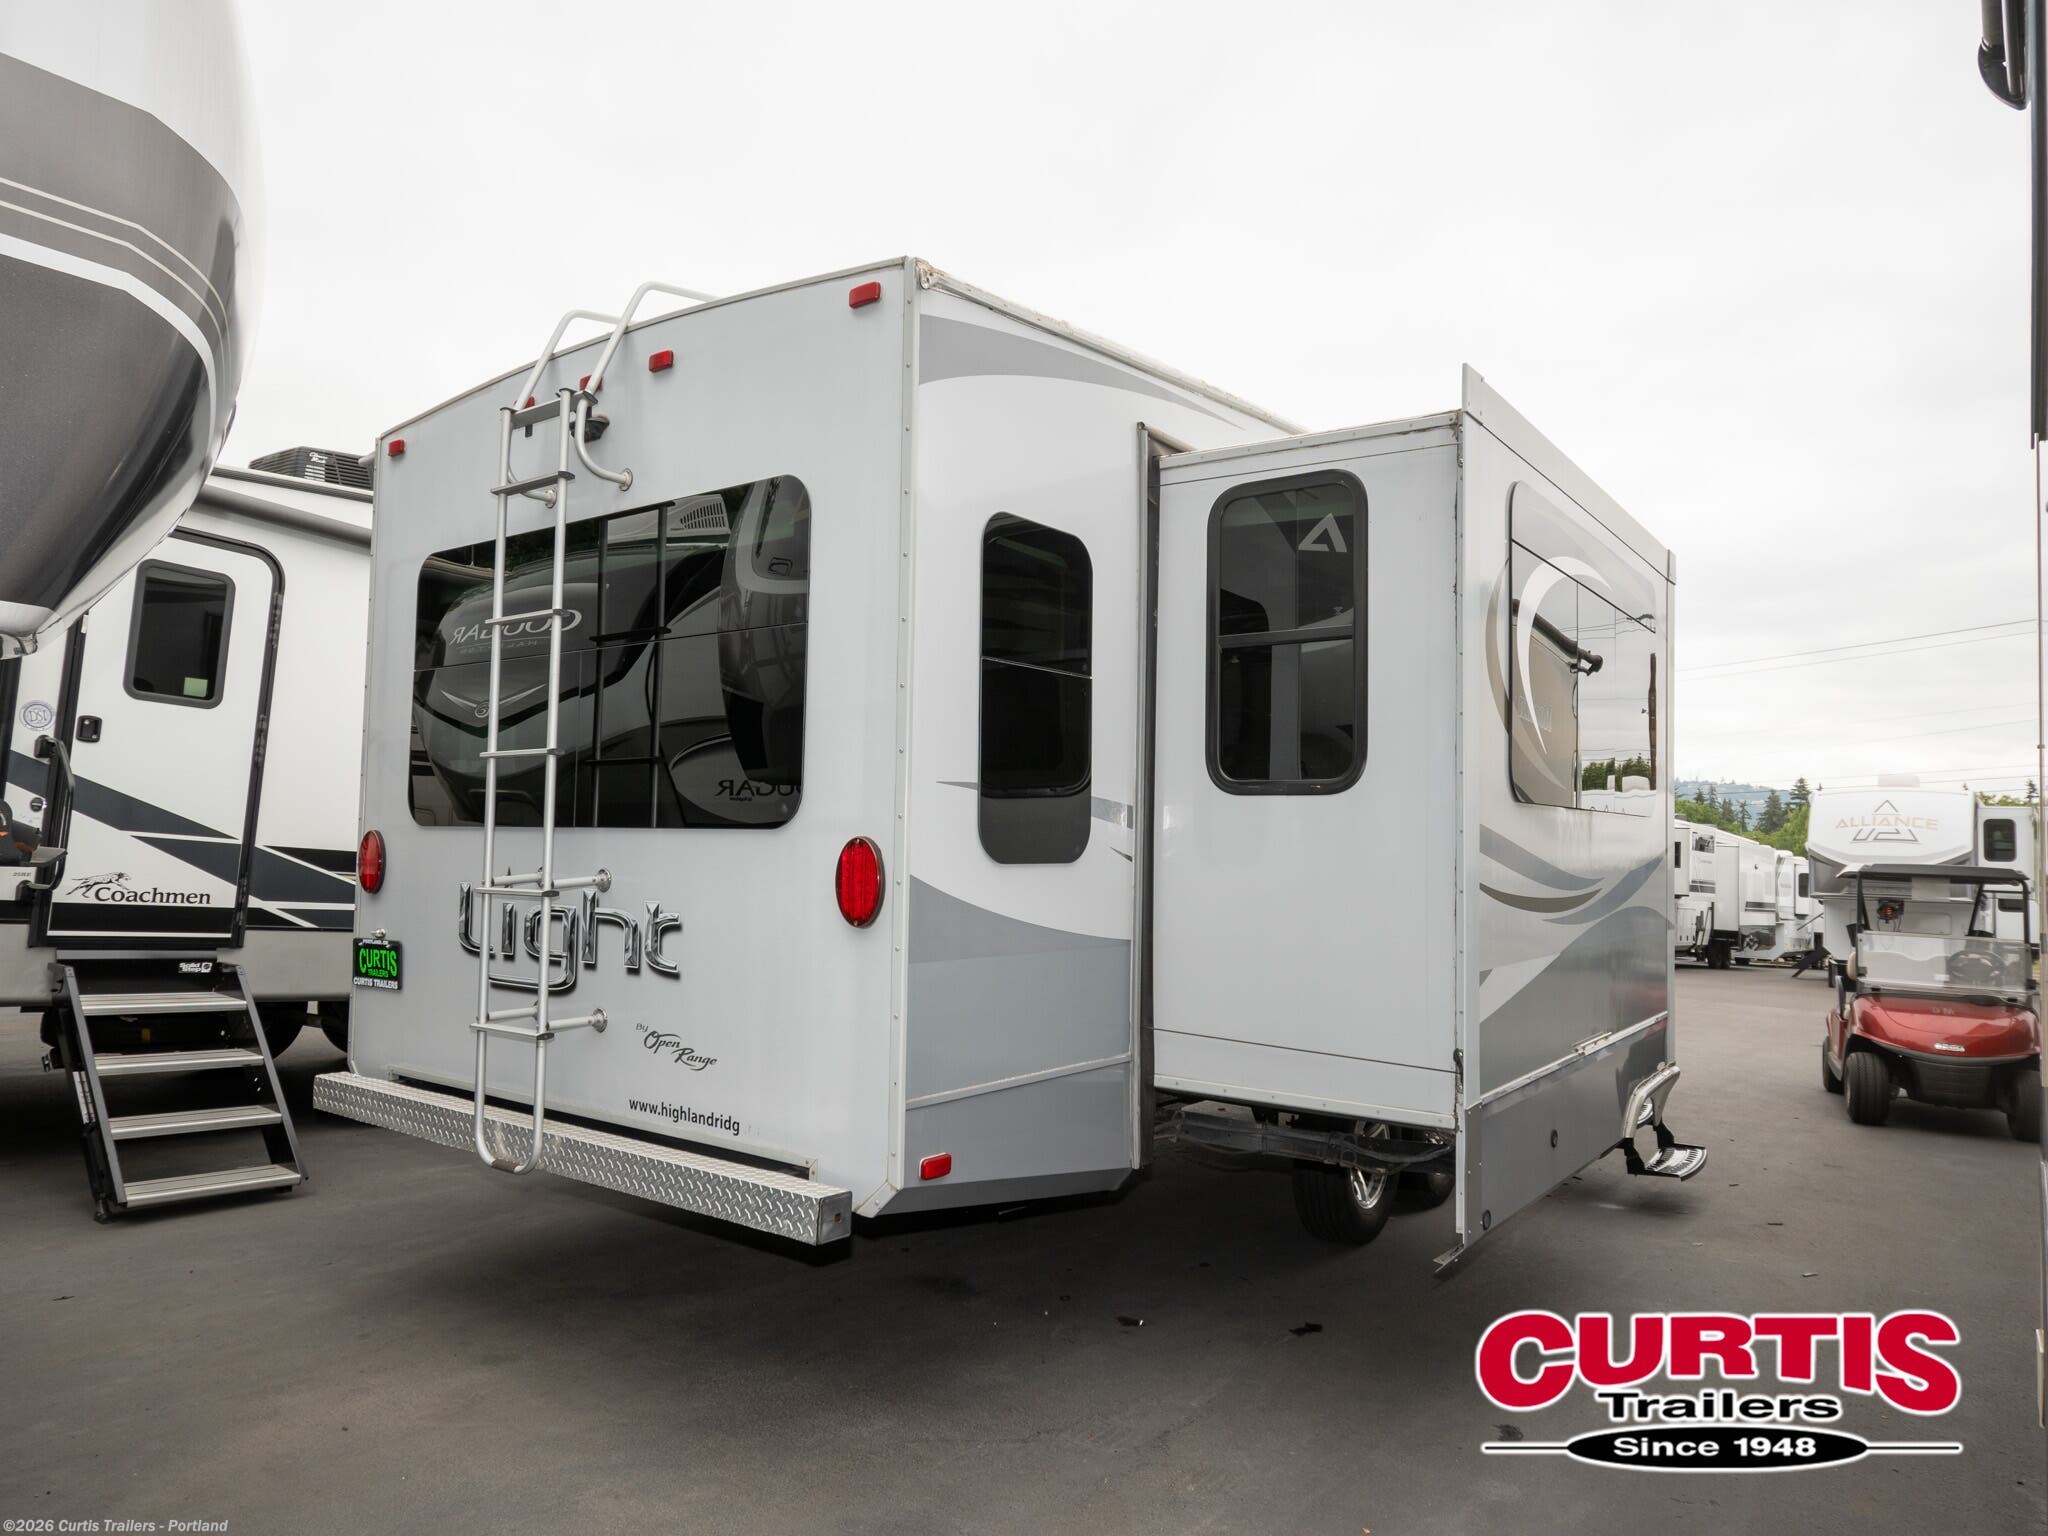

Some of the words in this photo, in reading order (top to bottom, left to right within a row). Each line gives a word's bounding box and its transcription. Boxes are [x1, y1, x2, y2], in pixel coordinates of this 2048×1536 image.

[1836, 816, 1938, 830] ALLIANCE
[95, 887, 211, 905] Coachmen
[359, 948, 397, 976] CURTIS
[353, 977, 373, 986] CURTIS
[373, 979, 398, 989] TRAILERS
[635, 1023, 649, 1032] By
[643, 1030, 681, 1054] Open
[671, 1047, 717, 1071] Range
[629, 1099, 740, 1136] www.highlandridg
